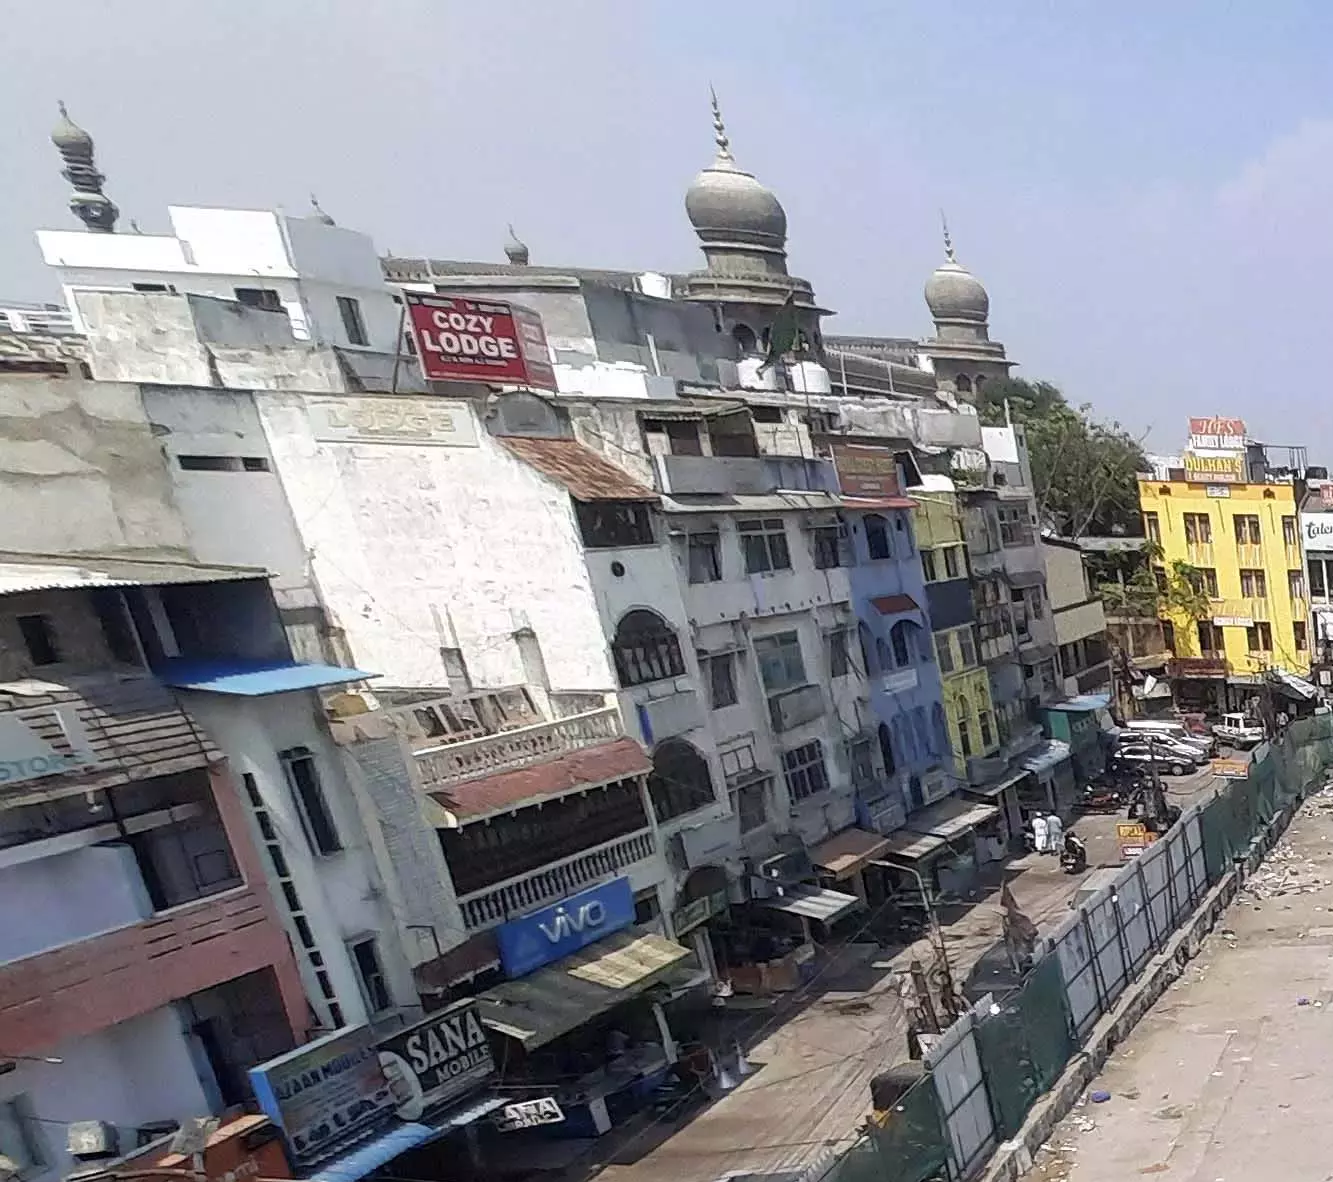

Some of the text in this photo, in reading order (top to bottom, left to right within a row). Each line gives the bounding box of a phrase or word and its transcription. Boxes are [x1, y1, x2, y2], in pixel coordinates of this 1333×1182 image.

[433, 310, 493, 334] COZY
[421, 329, 518, 359] LODGE
[537, 900, 606, 943] vivo
[406, 1010, 486, 1075] SANA
[435, 1045, 492, 1085] MOBILE
